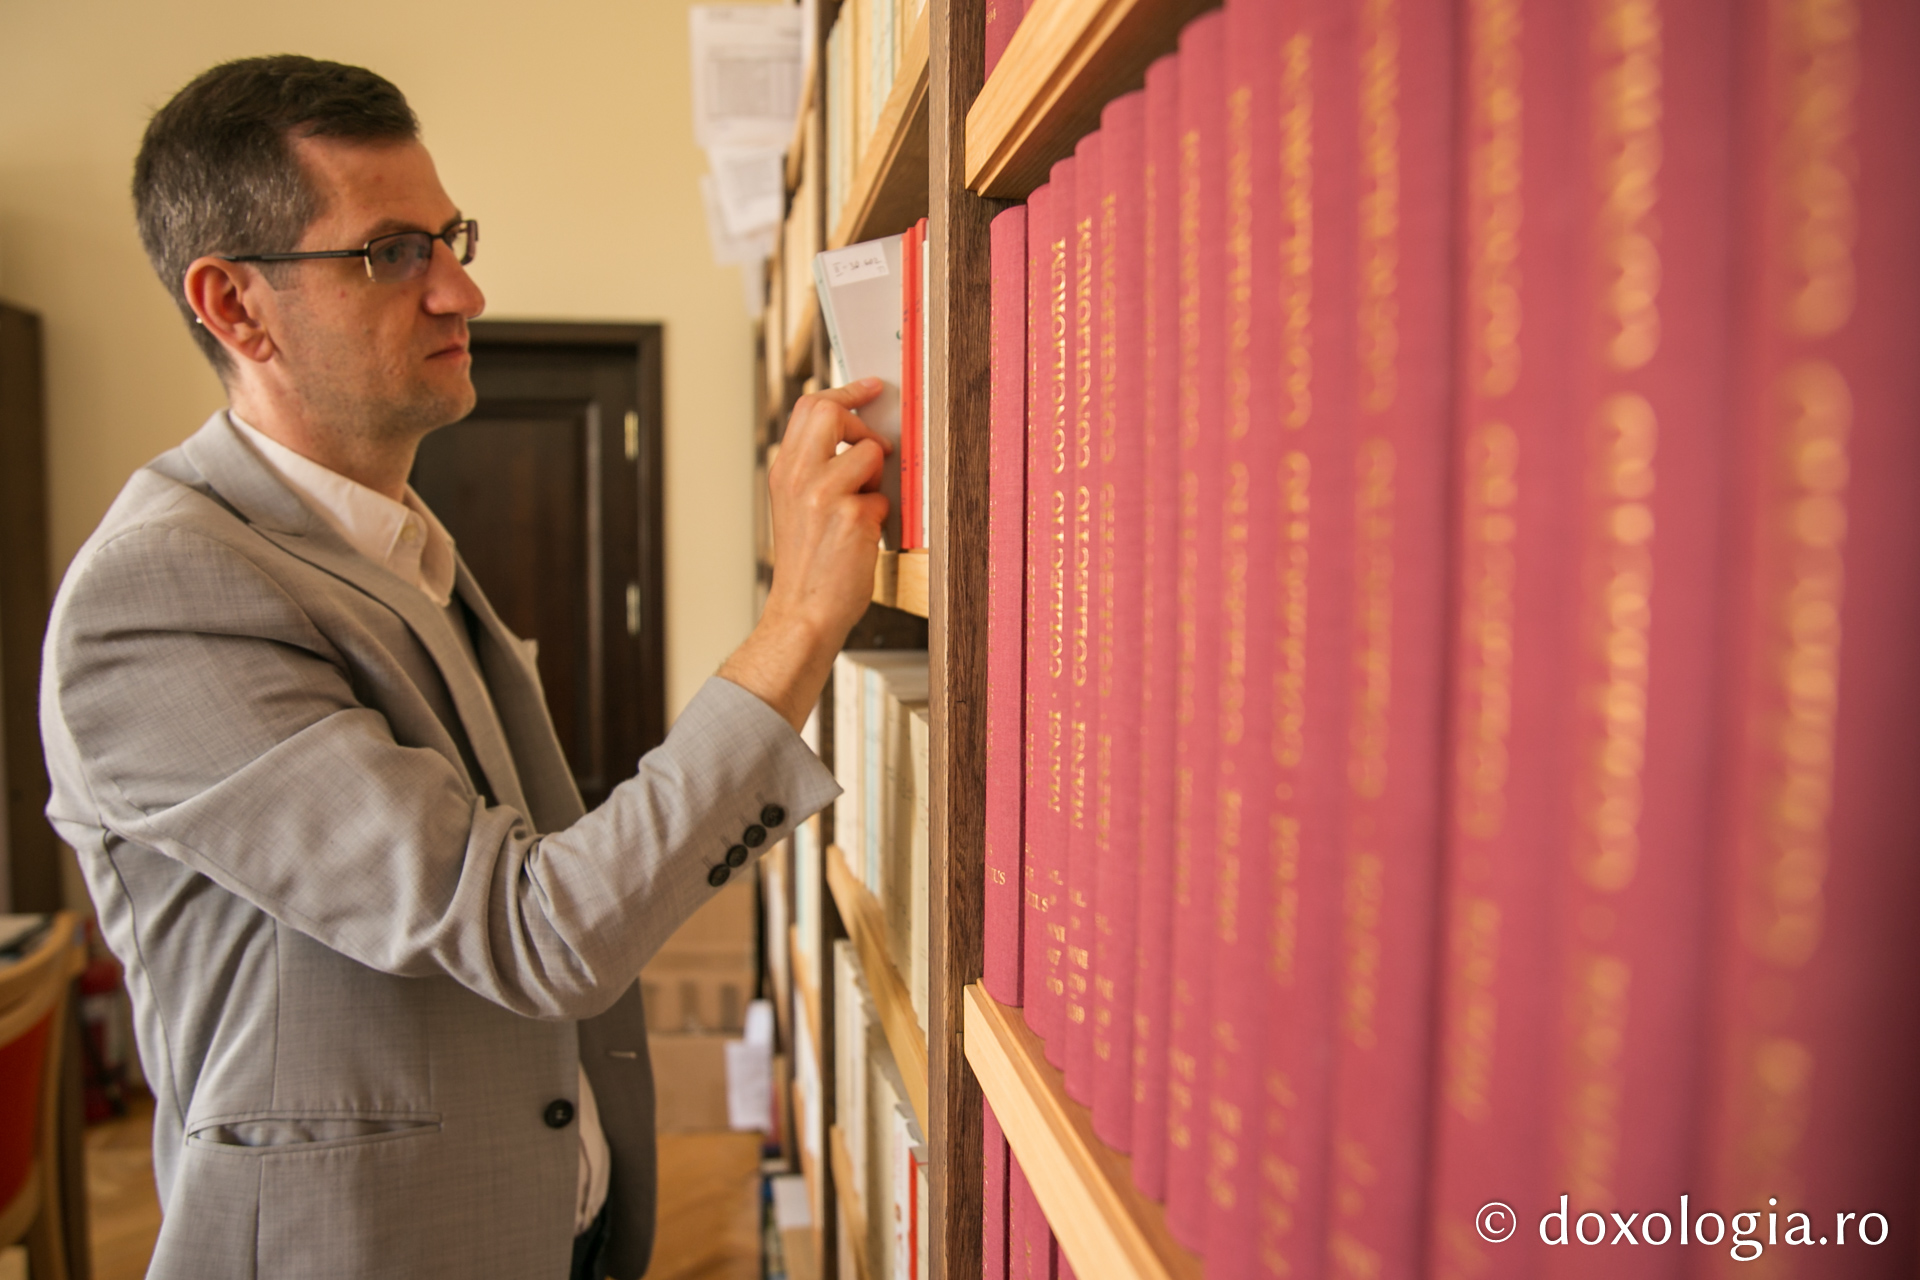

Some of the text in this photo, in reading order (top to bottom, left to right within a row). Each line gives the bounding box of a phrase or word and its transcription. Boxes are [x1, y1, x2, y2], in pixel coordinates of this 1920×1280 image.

[1048, 236, 1067, 812] MANSI COLLECTIO CONCILIORUM
[1071, 216, 1092, 828] MANSI COLLECTIO CONCILIORUM
